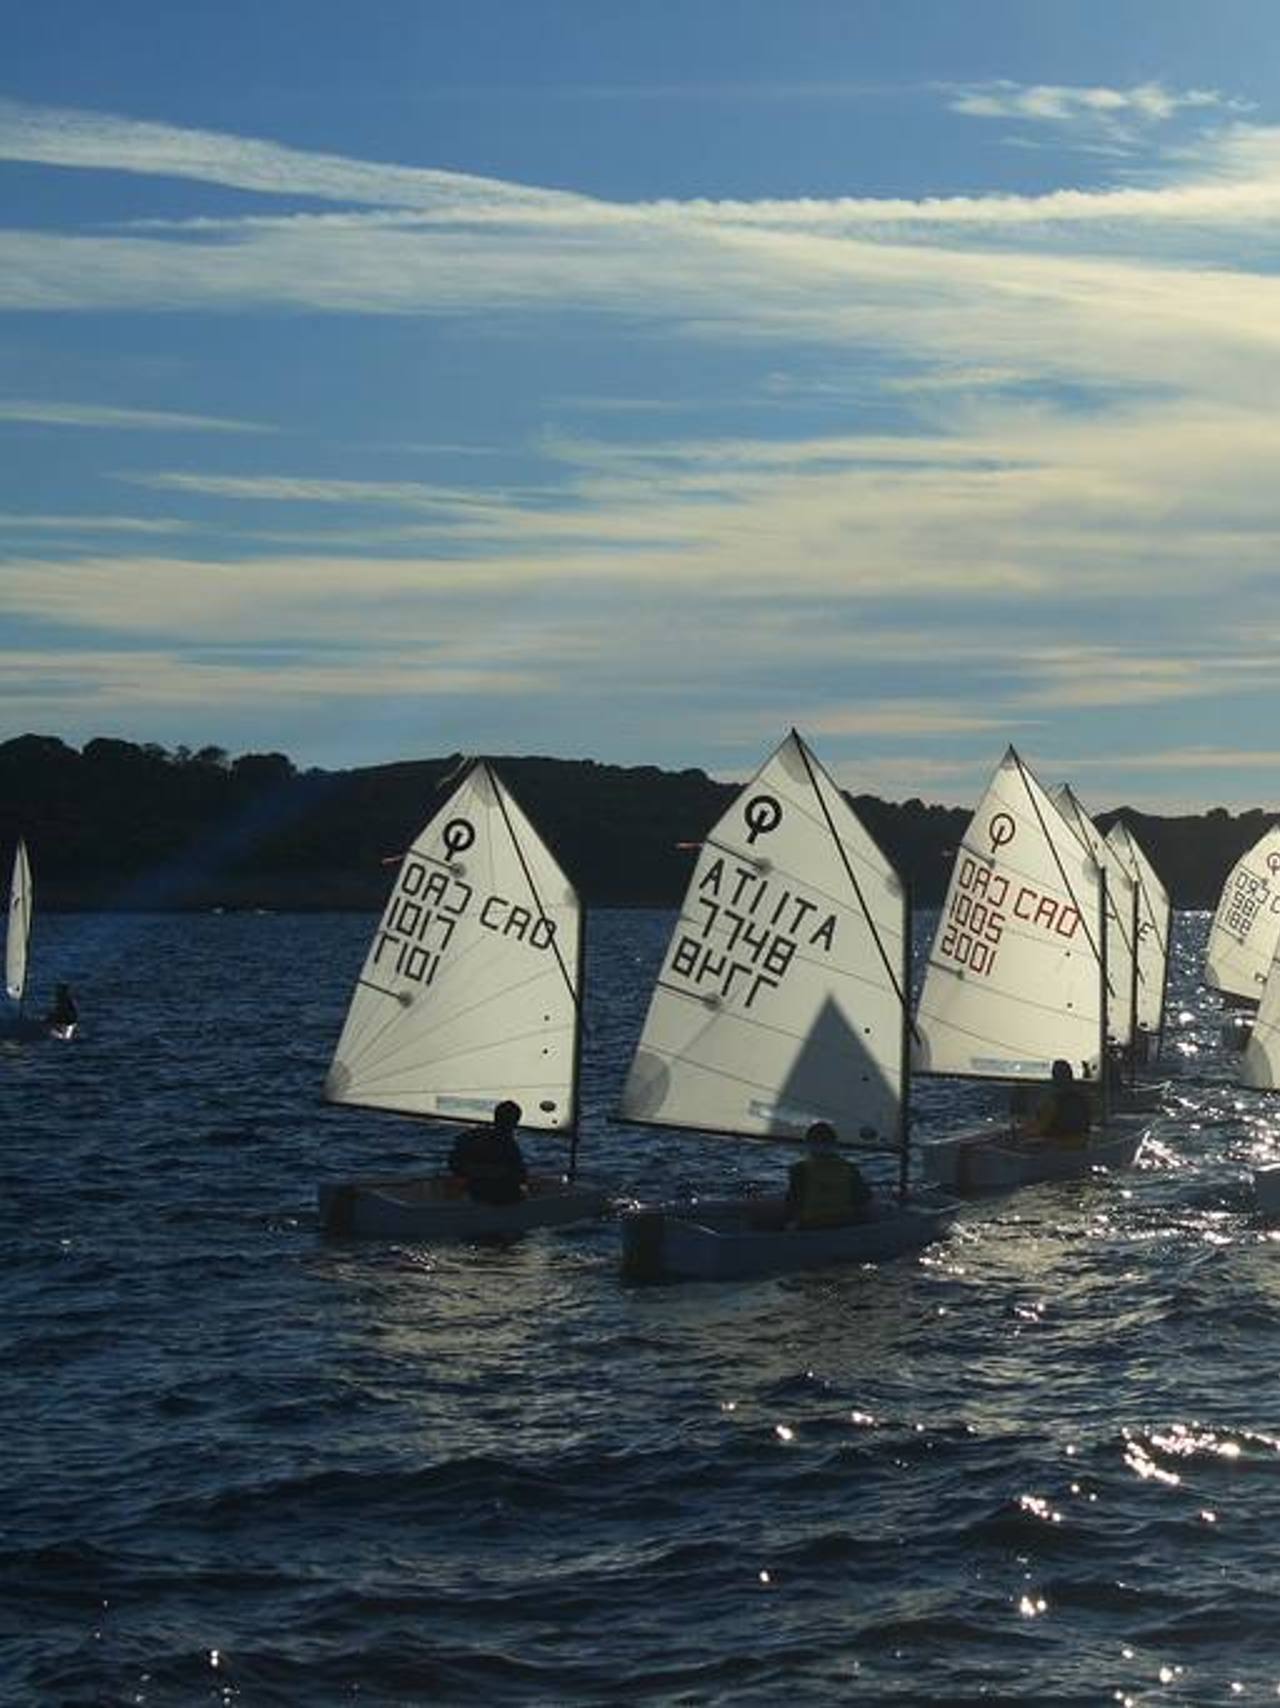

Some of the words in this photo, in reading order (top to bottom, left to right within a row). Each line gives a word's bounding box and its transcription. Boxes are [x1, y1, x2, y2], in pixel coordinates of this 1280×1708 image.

[699, 897, 797, 976] 7748
[771, 891, 837, 951] ITA
[949, 892, 1006, 944] 1005
